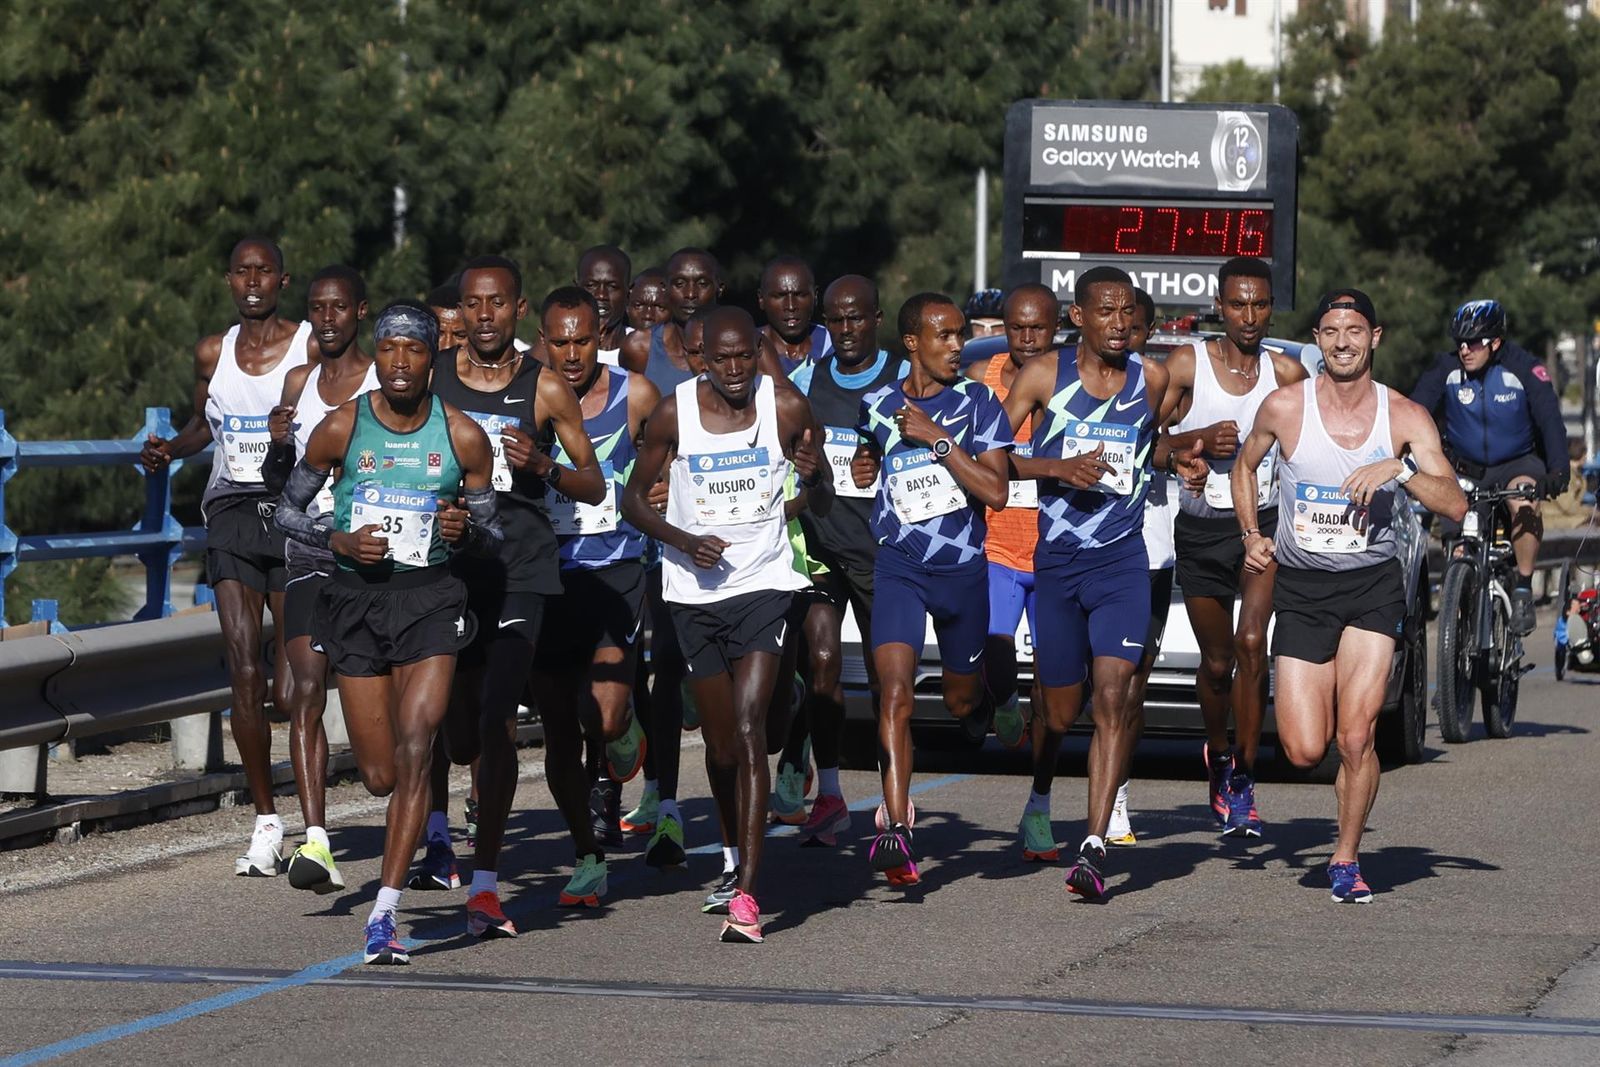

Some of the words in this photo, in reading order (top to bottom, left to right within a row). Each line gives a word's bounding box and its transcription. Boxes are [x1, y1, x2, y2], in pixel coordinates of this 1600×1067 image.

[1044, 123, 1148, 143] SAMSUNG
[1233, 127, 1249, 147] 12
[1042, 147, 1116, 171] Galaxy
[1120, 149, 1200, 169] Watch4
[1235, 157, 1247, 179] 6
[1052, 269, 1220, 297] MATHON
[244, 420, 269, 429] ZURI
[836, 432, 858, 443] ZURI
[1092, 427, 1128, 438] ZURICH
[717, 453, 756, 467] ZURICH
[905, 451, 936, 465] ZURIC
[708, 478, 756, 495] KUSURO
[906, 474, 941, 492] BAYSA
[383, 493, 425, 507] ZURICH
[729, 495, 737, 503] 13
[920, 490, 931, 500] 26
[381, 515, 404, 534] 35
